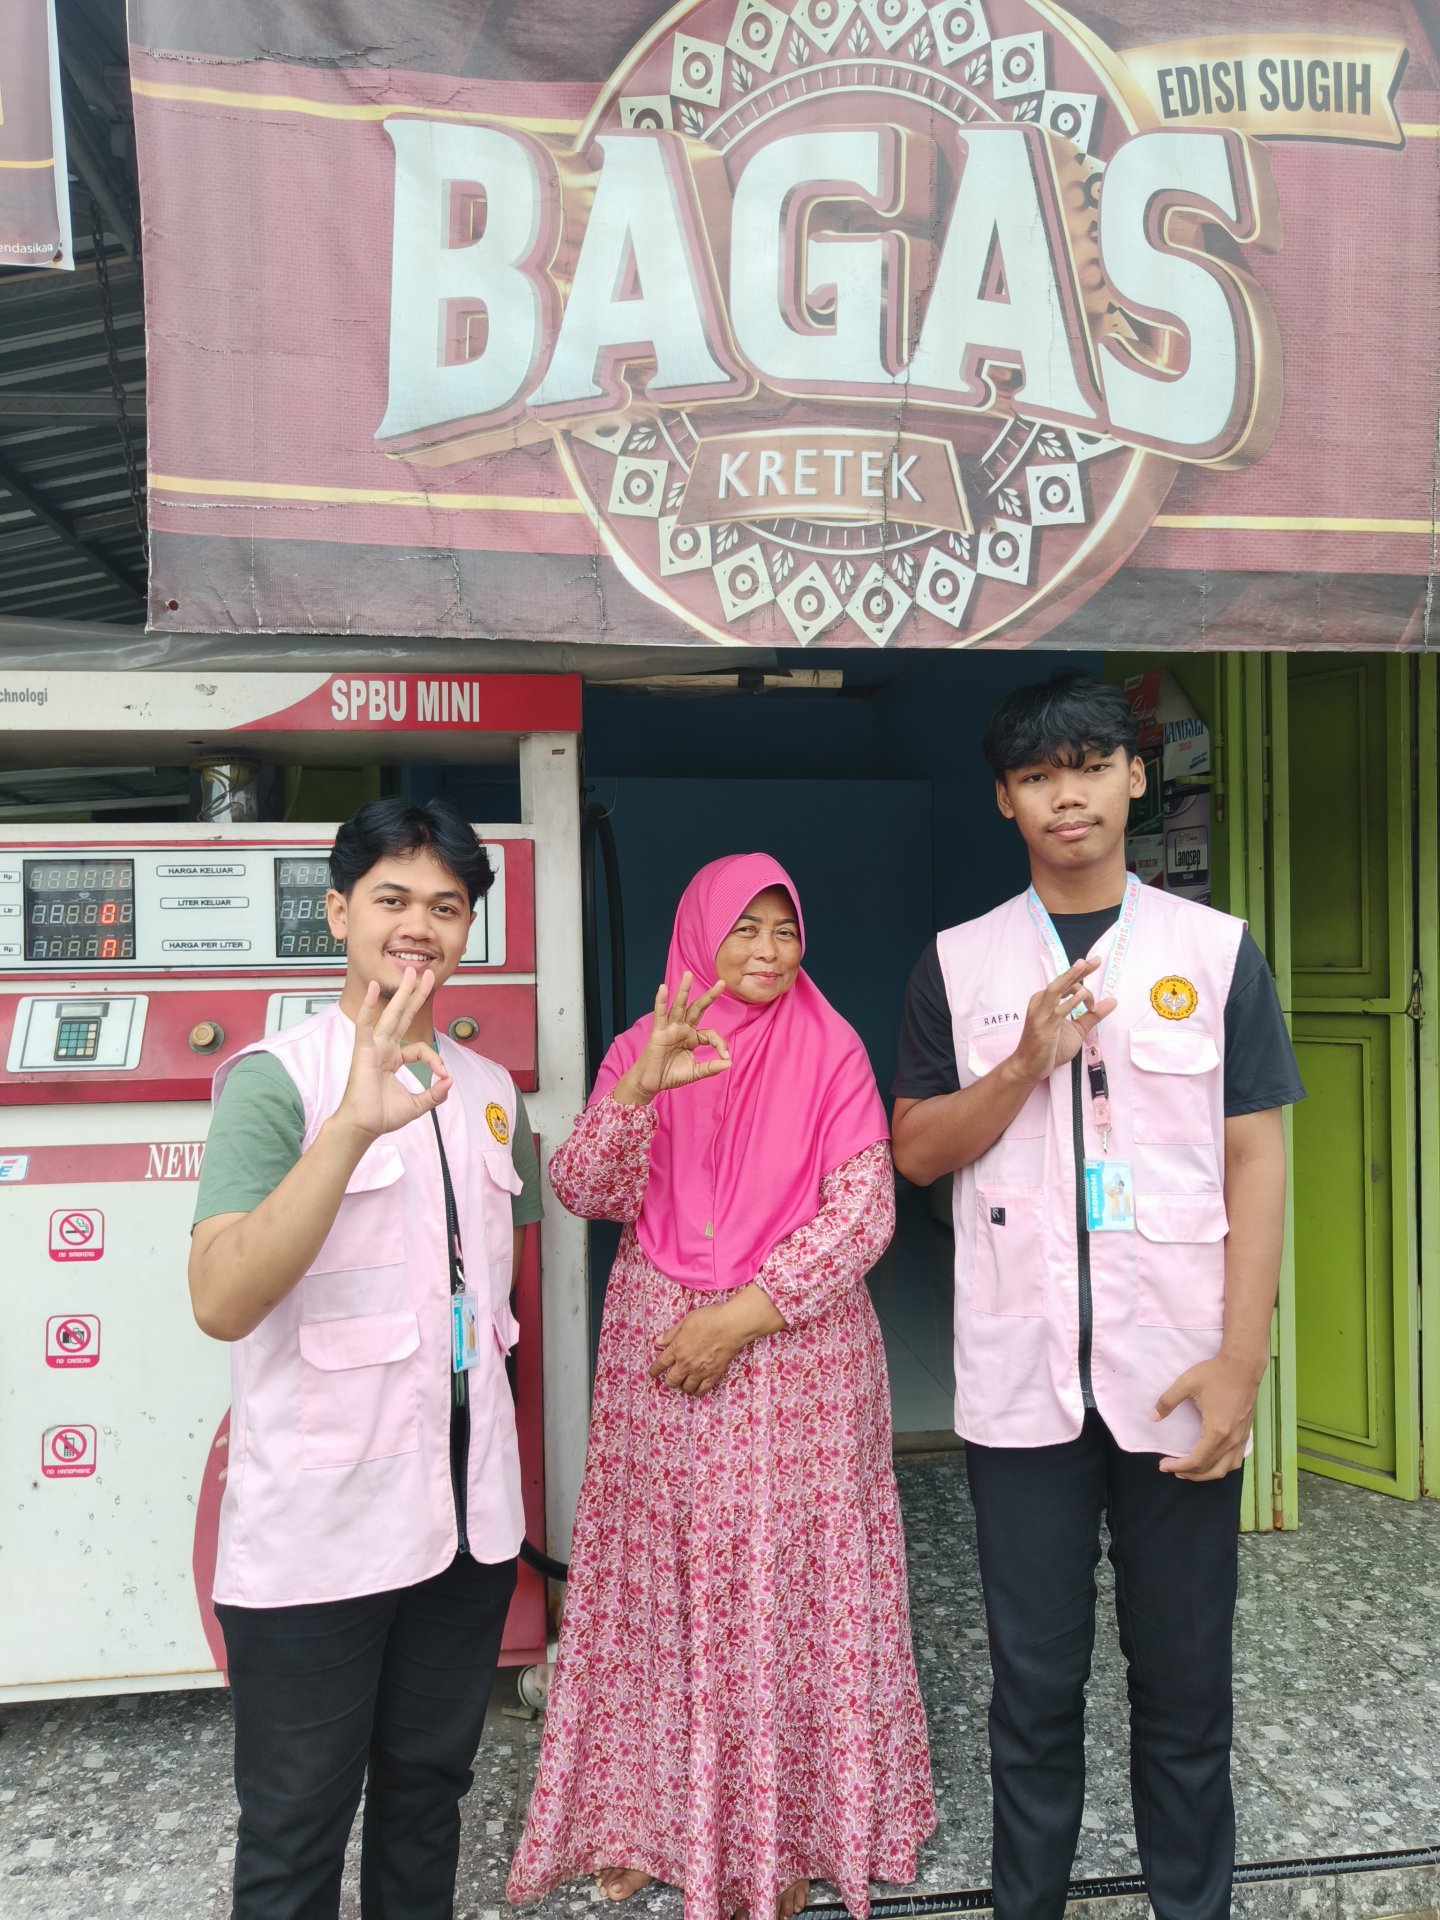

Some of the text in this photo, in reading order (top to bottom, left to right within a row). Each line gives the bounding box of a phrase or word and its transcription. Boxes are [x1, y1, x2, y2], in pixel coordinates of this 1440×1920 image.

[1157, 58, 1371, 119] EDISI SUGIH
[374, 118, 1248, 450] BAGAS
[718, 449, 923, 502] KRETEK
[331, 679, 480, 722] SPBU MINI
[169, 941, 244, 949] HARGA PER LITER
[983, 1012, 1019, 1026] RAFFA
[144, 1143, 206, 1179] NEW
